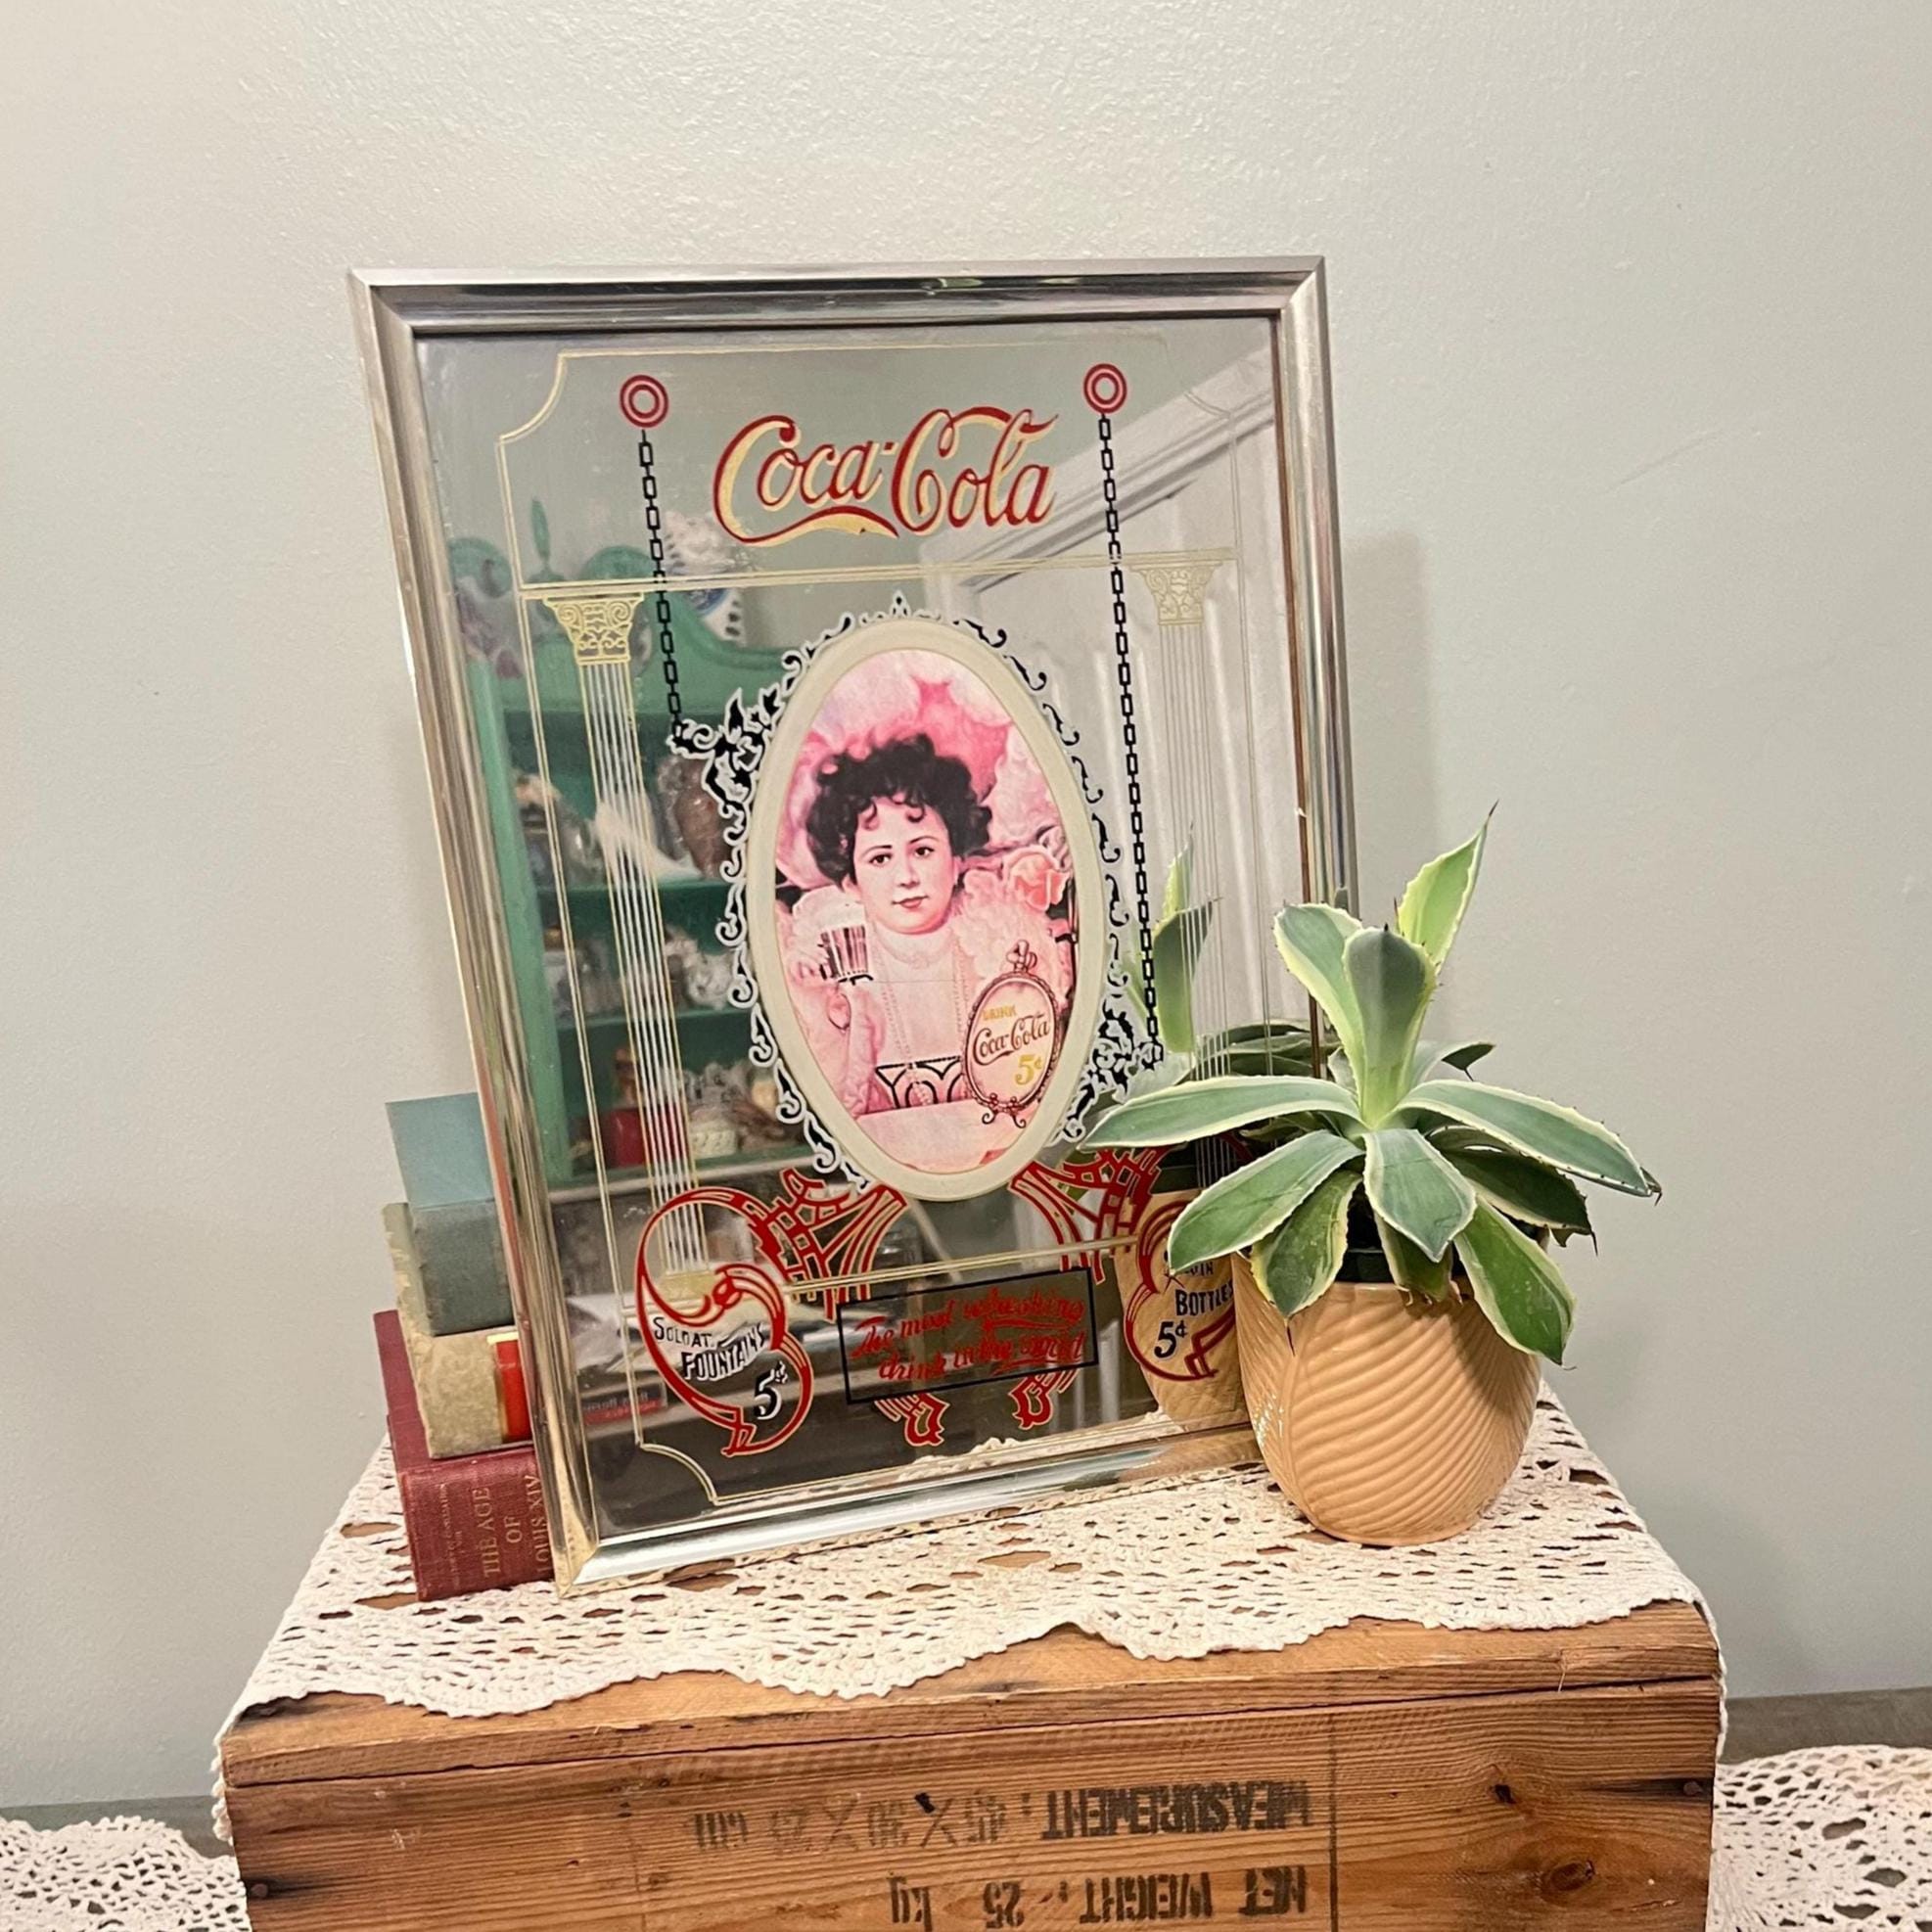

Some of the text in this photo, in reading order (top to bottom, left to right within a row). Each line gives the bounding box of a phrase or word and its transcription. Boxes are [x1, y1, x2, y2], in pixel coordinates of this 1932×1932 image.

[713, 406, 1059, 547] Coca-Cola
[973, 1013, 1049, 1065] Coca-Cola
[680, 1321, 766, 1382] FOUNTAINS
[472, 1488, 501, 1578] THE AGE
[504, 1515, 523, 1543] OF
[887, 1875, 934, 1932] kg
[982, 1879, 1026, 1929] 25
[1238, 1865, 1307, 1915] NET
